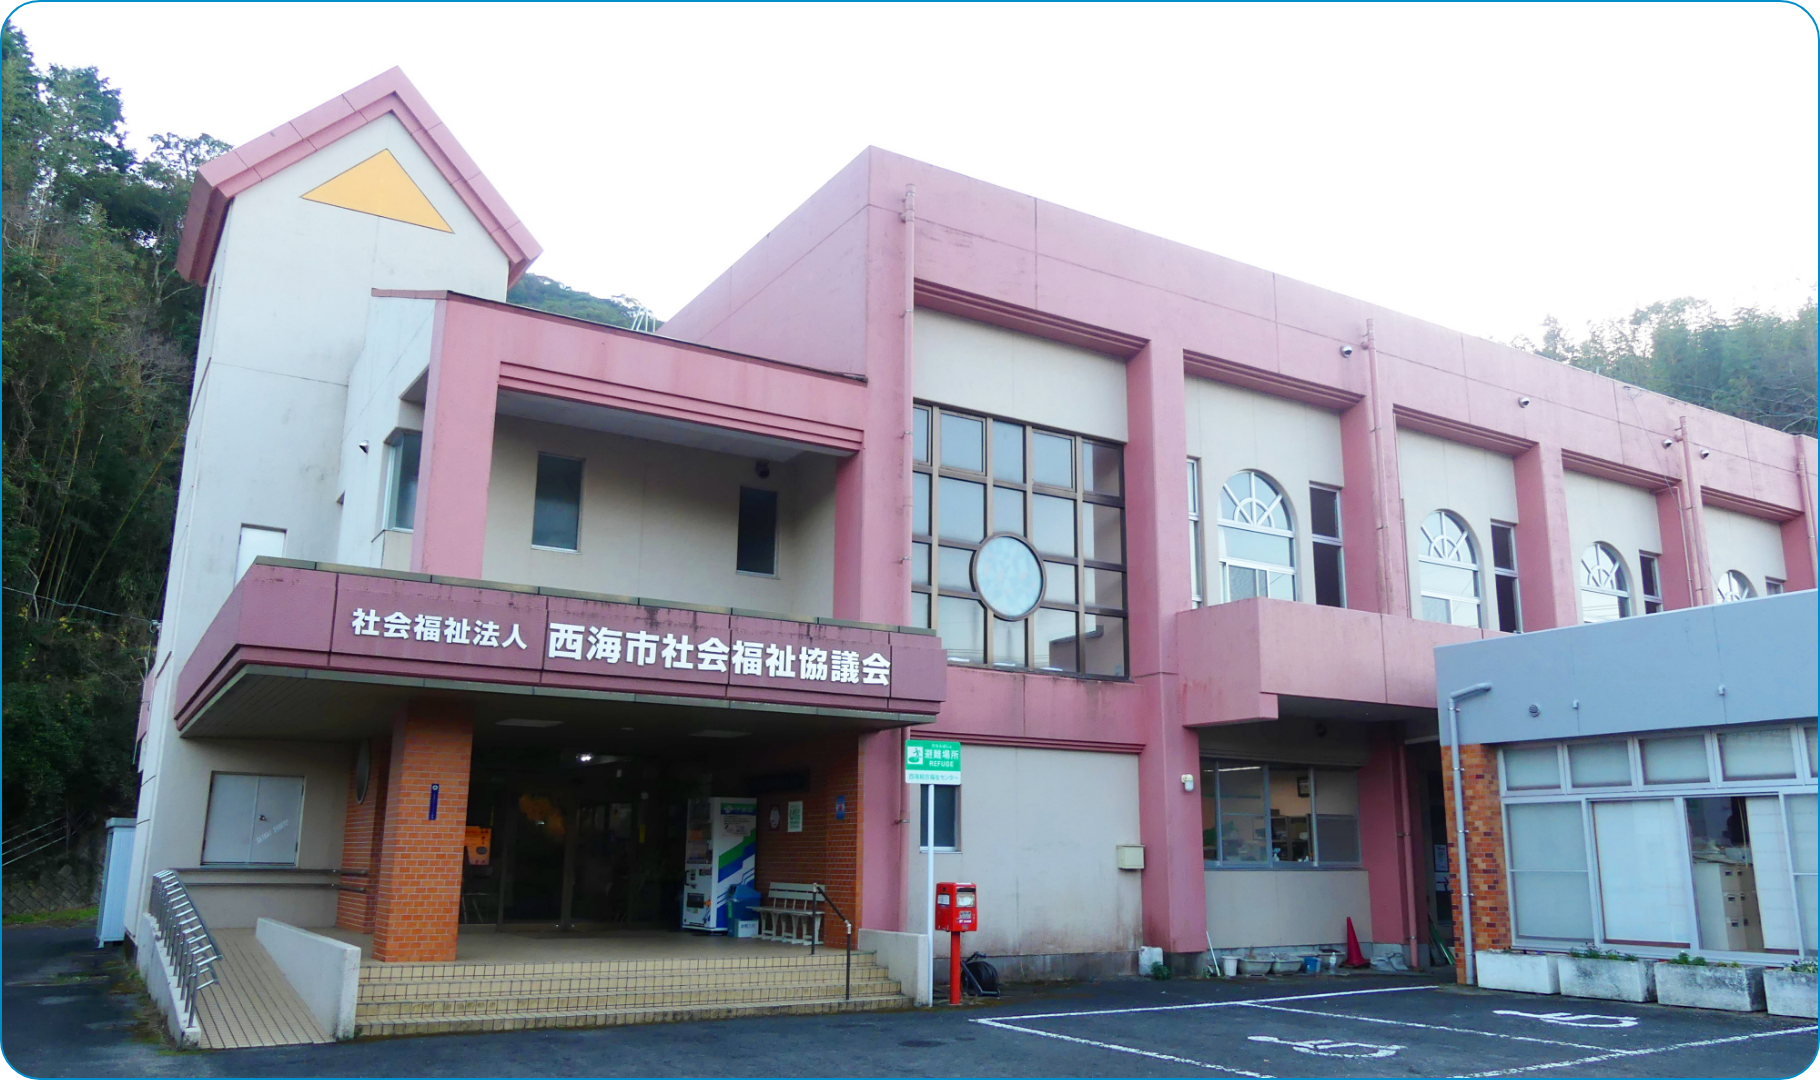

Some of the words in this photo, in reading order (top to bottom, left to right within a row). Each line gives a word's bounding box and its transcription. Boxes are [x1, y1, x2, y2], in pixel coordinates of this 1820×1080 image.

[351, 607, 528, 650] 社会福祉法人
[547, 622, 892, 686] 西海市社会福祉協議会
[924, 749, 958, 760] 避難場所
